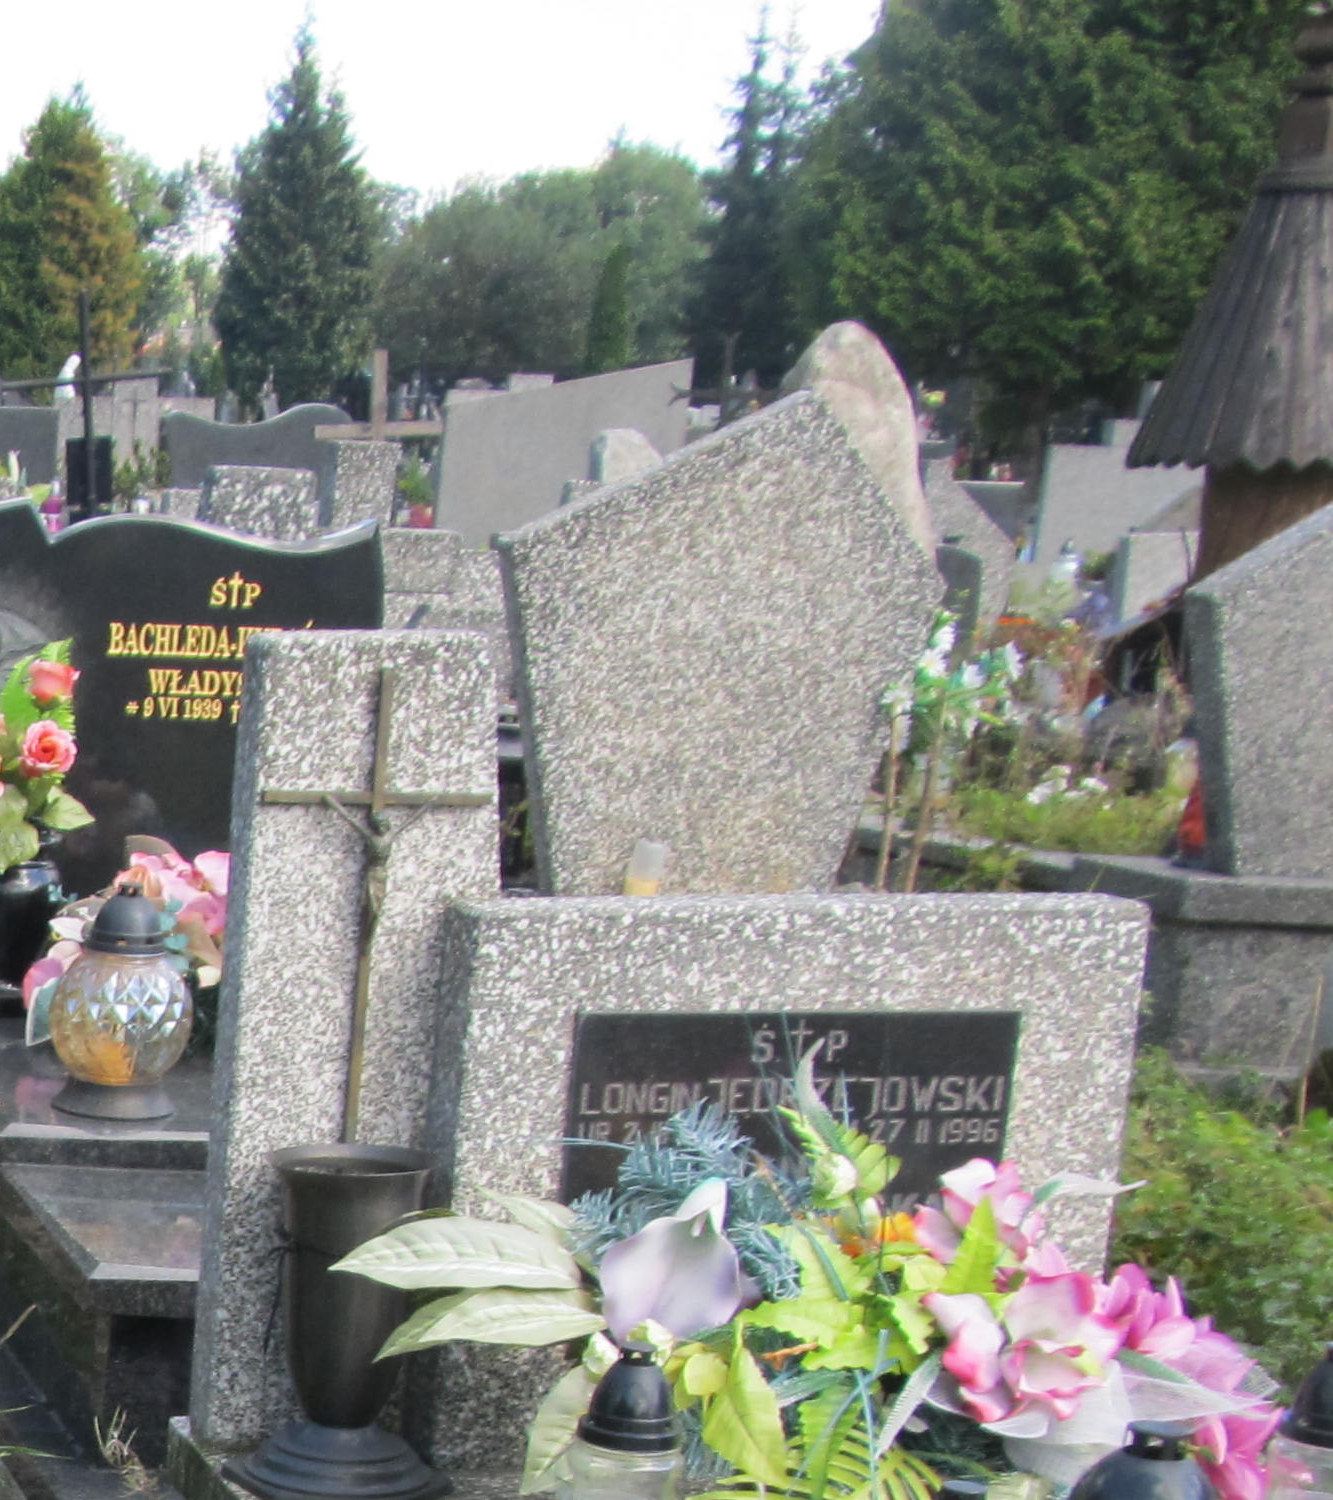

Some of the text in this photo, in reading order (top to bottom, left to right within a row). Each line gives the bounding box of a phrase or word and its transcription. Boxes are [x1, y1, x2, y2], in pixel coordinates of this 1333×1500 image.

[143, 696, 223, 719] 9 VI 1939
[578, 1082, 703, 1116] LONGIN
[869, 1118, 906, 1145] 27
[938, 1117, 1001, 1144] 1996
